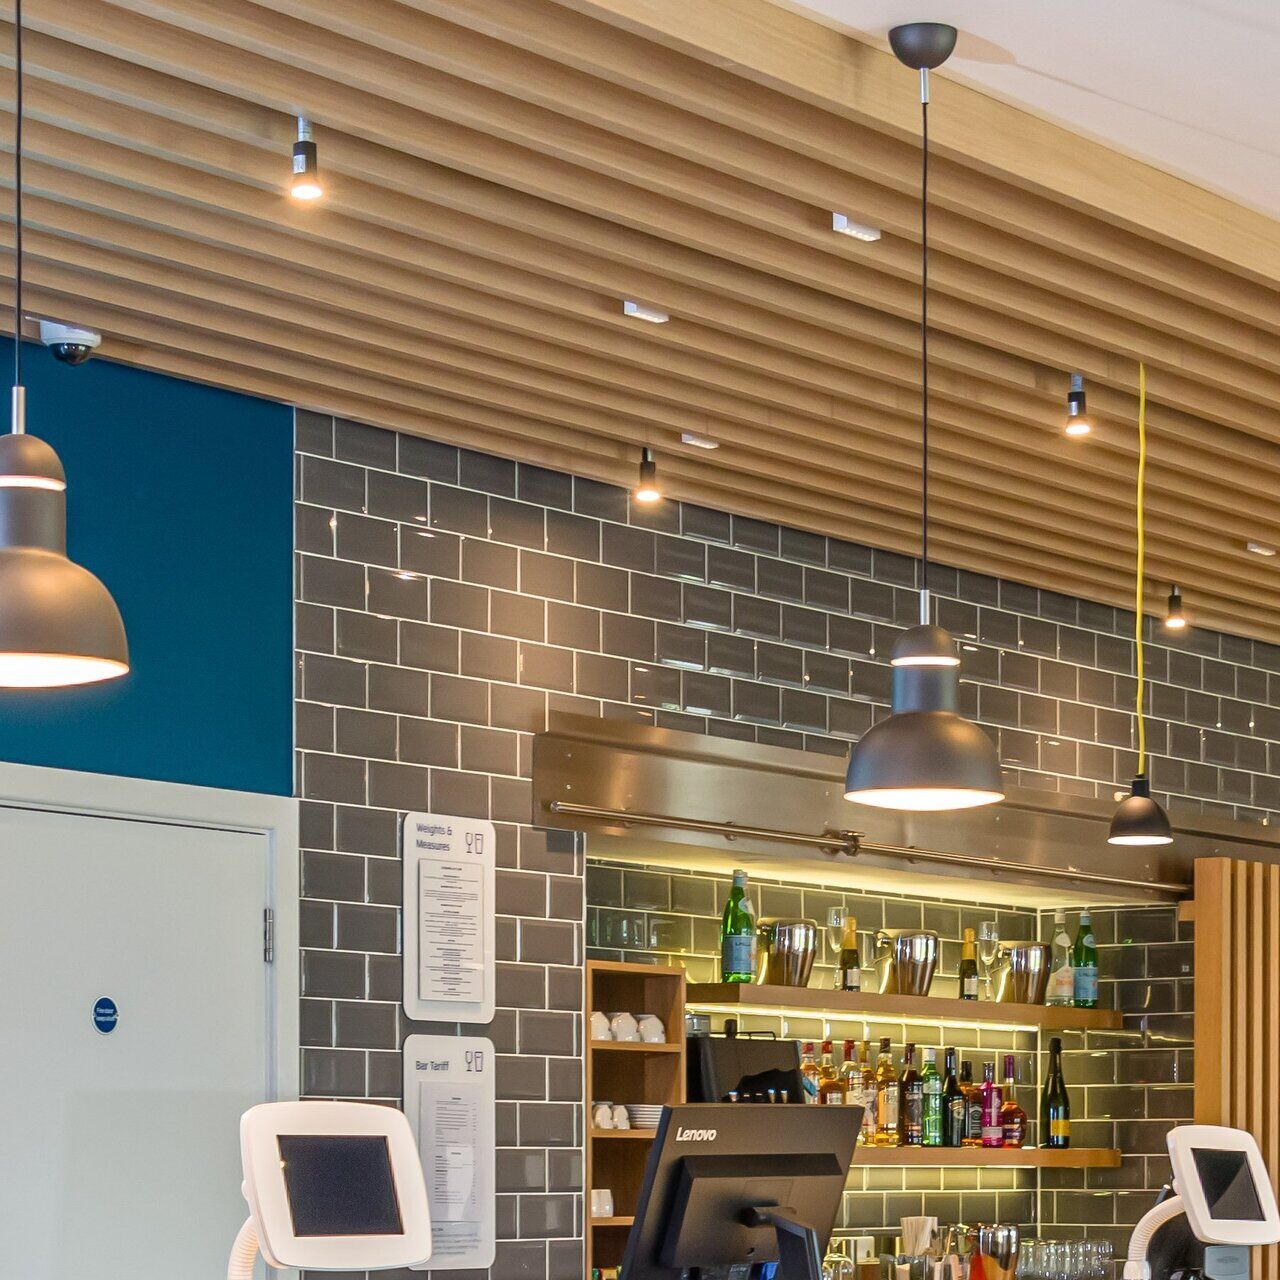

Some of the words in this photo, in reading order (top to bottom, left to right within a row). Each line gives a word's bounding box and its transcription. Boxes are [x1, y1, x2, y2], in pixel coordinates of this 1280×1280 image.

[416, 823, 446, 837] Weights
[446, 826, 453, 836] &
[416, 839, 450, 852] Measures
[415, 1061, 428, 1071] Bar
[430, 1061, 449, 1071] Tariff
[676, 1127, 717, 1141] Lenovo
